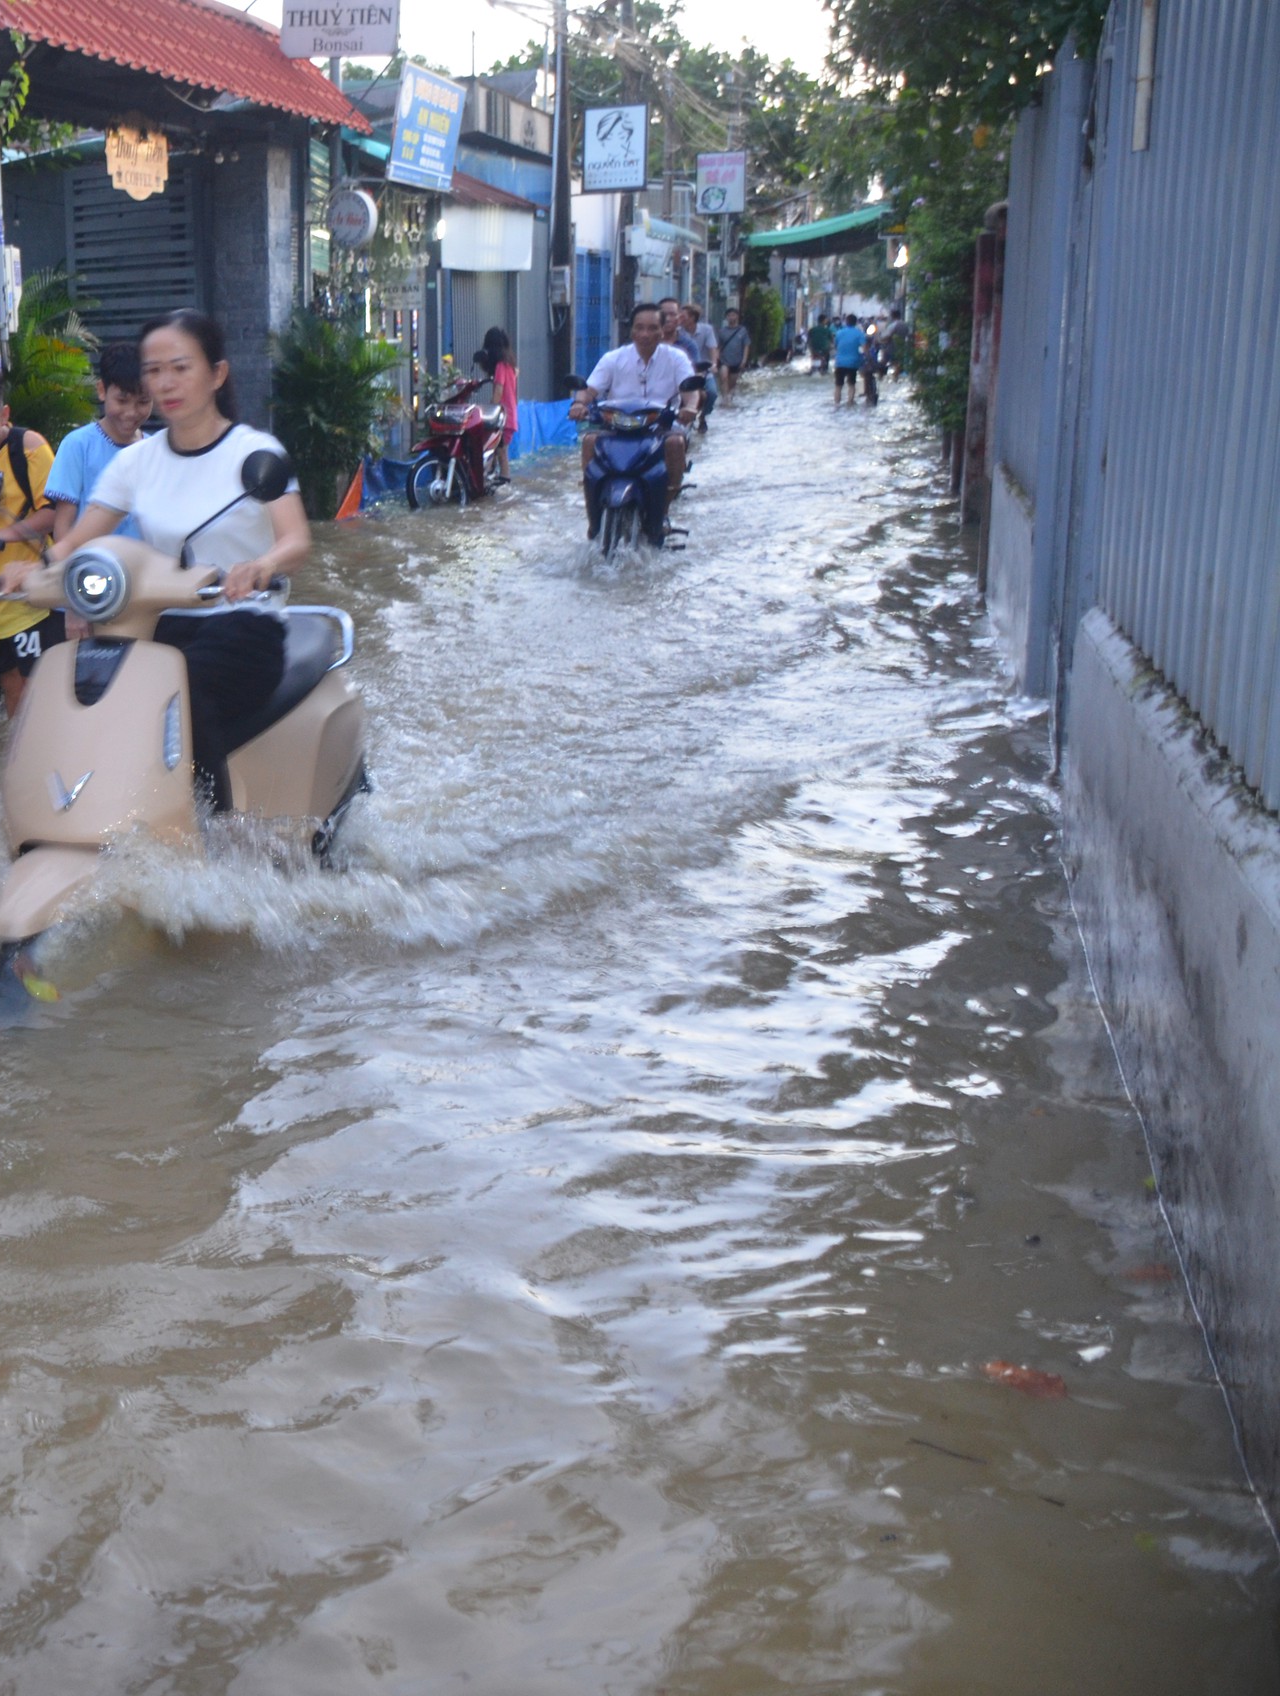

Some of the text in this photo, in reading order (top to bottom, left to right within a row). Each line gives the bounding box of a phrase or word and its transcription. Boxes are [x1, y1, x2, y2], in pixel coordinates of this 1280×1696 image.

[346, 4, 393, 25] TIÊN
[312, 36, 364, 52] Bonsai
[14, 631, 41, 658] 24
